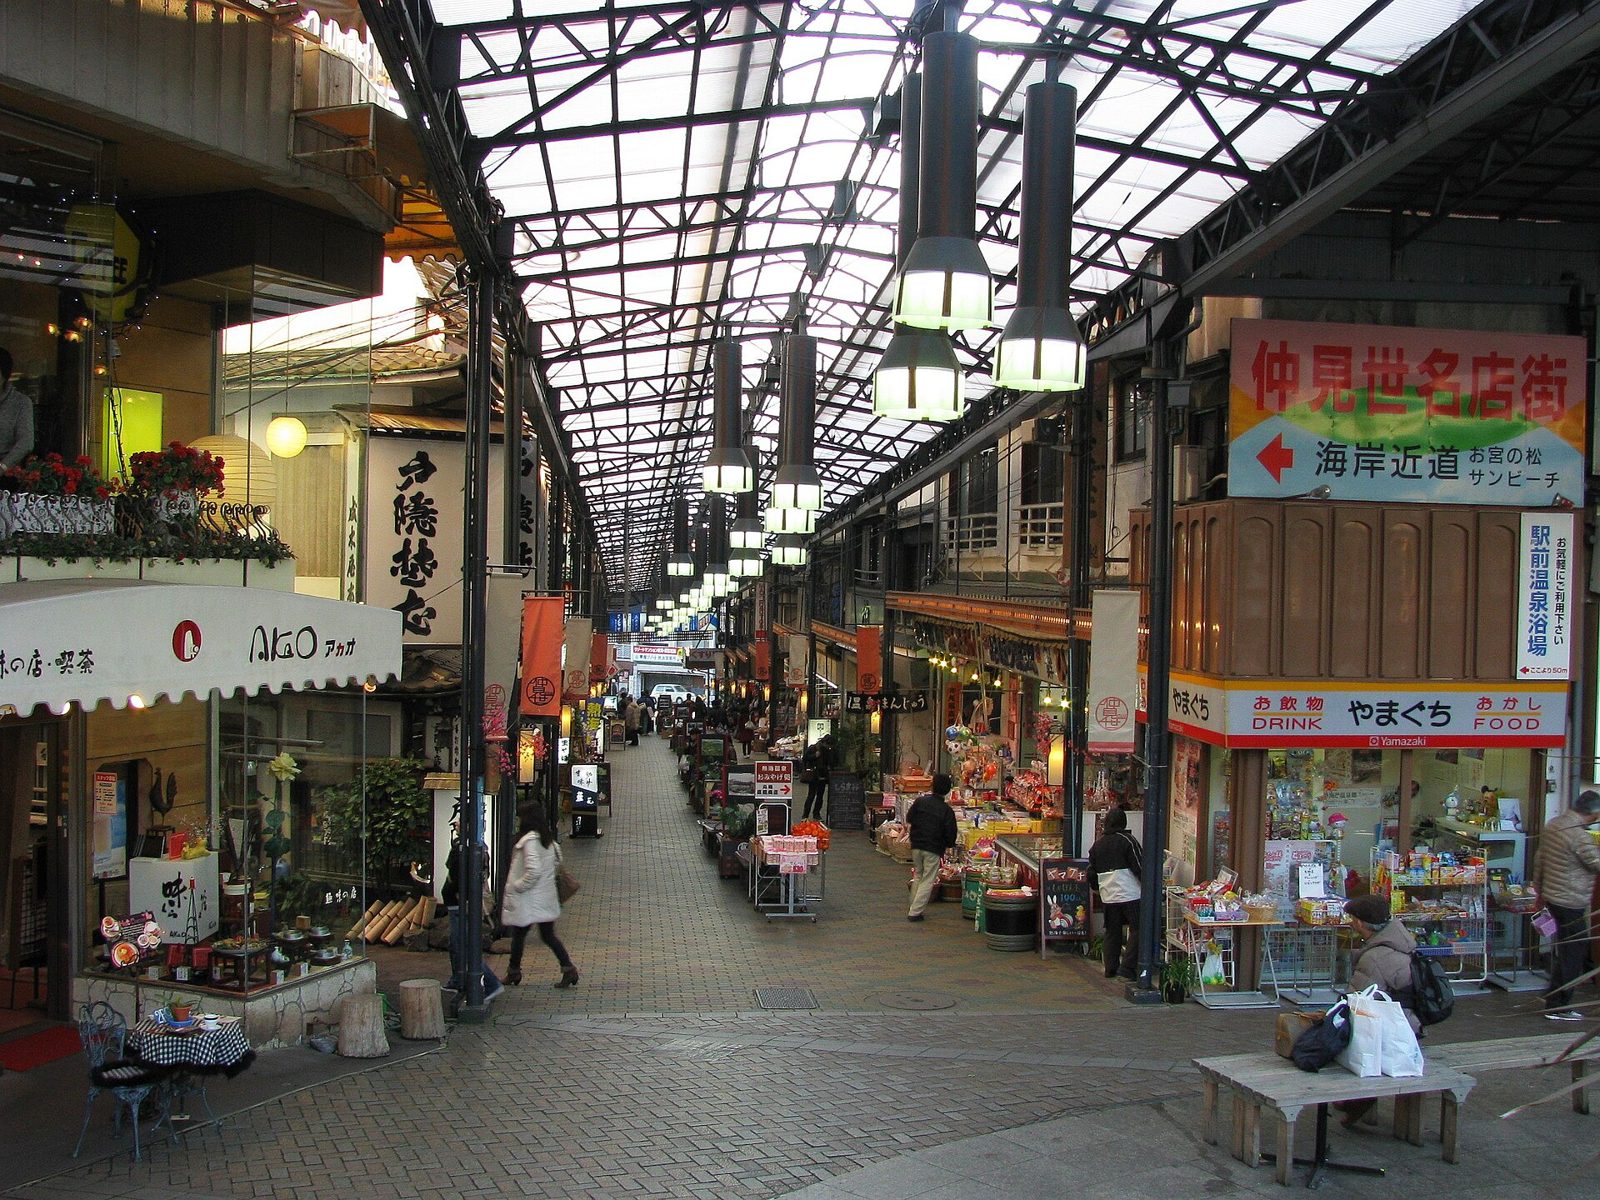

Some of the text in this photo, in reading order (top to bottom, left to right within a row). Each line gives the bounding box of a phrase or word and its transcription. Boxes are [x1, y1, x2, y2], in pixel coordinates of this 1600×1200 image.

[1251, 339, 1567, 422] 仲見世名店街
[1315, 440, 1460, 480] 海岸近道
[1469, 446, 1542, 466] お宮の松
[1468, 469, 1560, 488] サンビーチ
[1527, 525, 1551, 657] 駅前温泉浴場
[1553, 537, 1567, 646] お気軽にご利用下さい
[325, 637, 356, 658] アカオ
[1172, 687, 1209, 721] やまぐち
[1253, 696, 1324, 711] お飲物
[1348, 699, 1451, 728] やまぐち
[1476, 696, 1542, 711] おかし
[1252, 717, 1322, 730] DRINK
[1473, 718, 1540, 730] FOOD
[1381, 735, 1426, 747] Yamazaki
